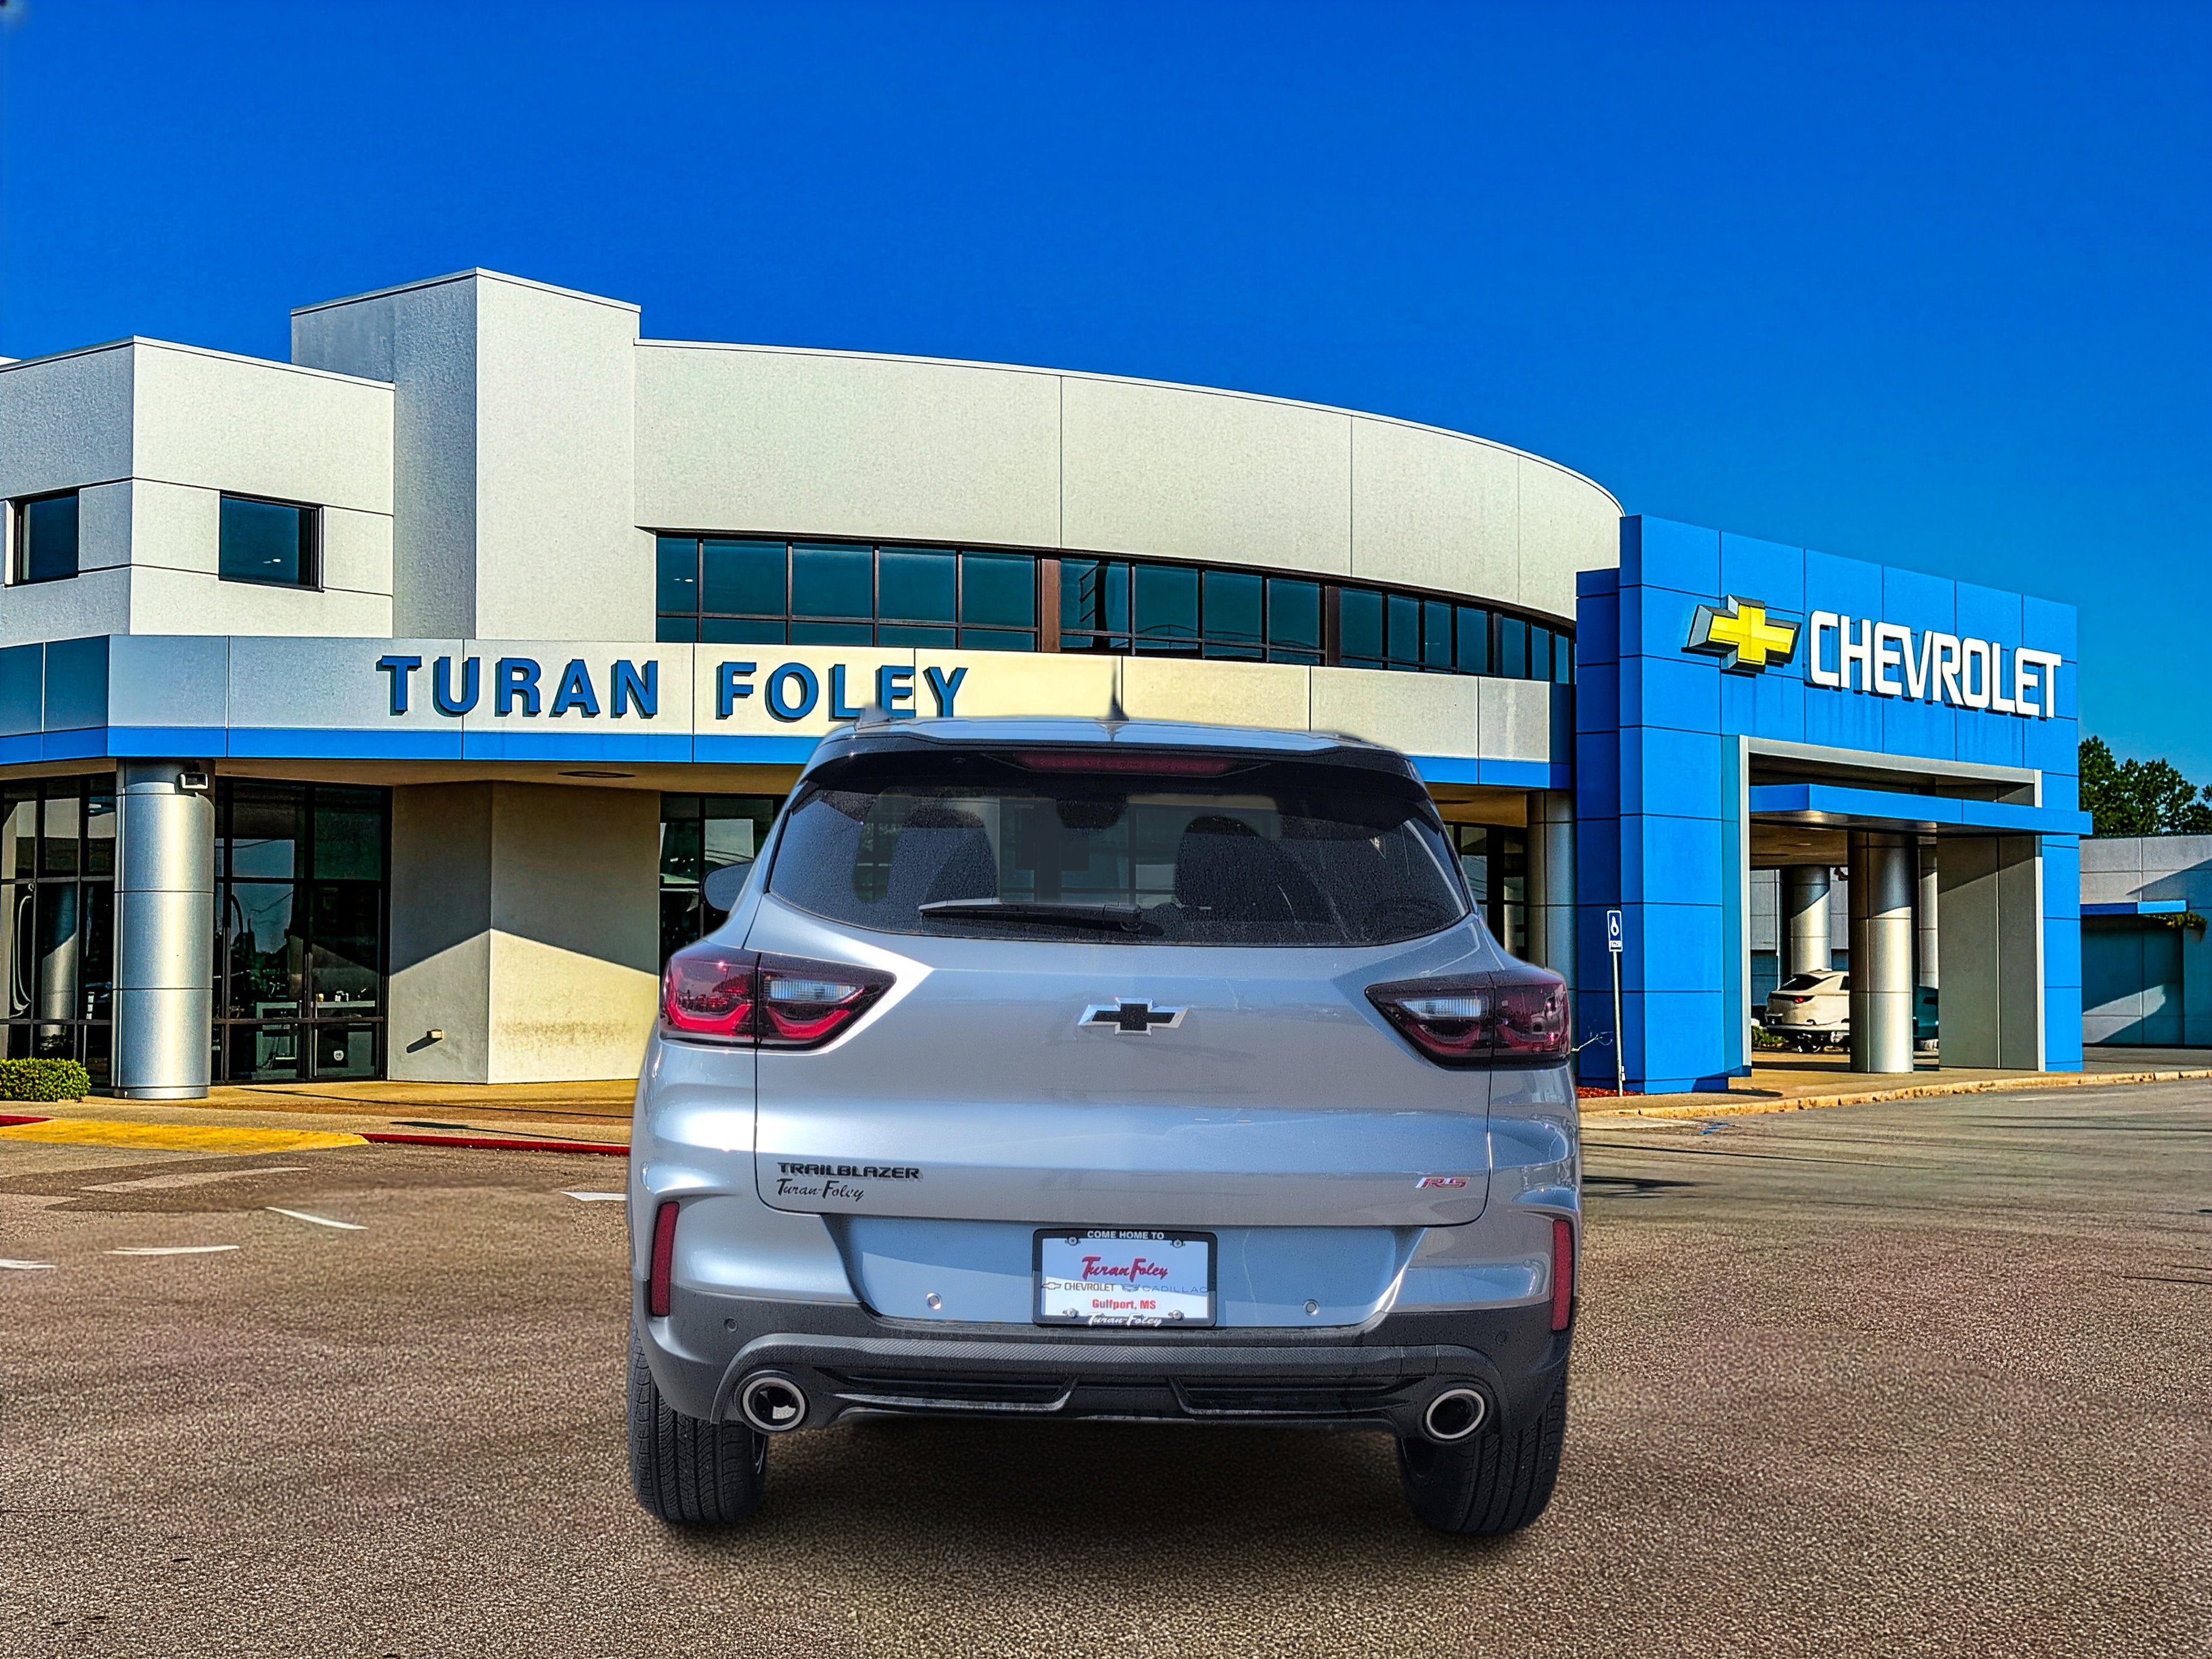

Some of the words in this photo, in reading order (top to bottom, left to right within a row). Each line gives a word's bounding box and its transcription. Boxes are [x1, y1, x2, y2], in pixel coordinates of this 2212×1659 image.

[1808, 610, 2062, 719] CHEVROLET
[376, 655, 658, 718] TURAN
[716, 661, 968, 723] FOLEY
[776, 1162, 920, 1179] TRAILBLAZER
[1415, 1176, 1470, 1188] RS
[1087, 1230, 1116, 1239] COME
[1119, 1231, 1149, 1240] HOME
[1150, 1232, 1165, 1240] TO
[1082, 1256, 1130, 1281] Turan
[1129, 1258, 1168, 1283] Foley
[1064, 1282, 1114, 1291] CHEVROLET
[1142, 1285, 1208, 1293] CADILLAC
[1092, 1299, 1137, 1310] Gulfport,
[1140, 1300, 1156, 1309] MS
